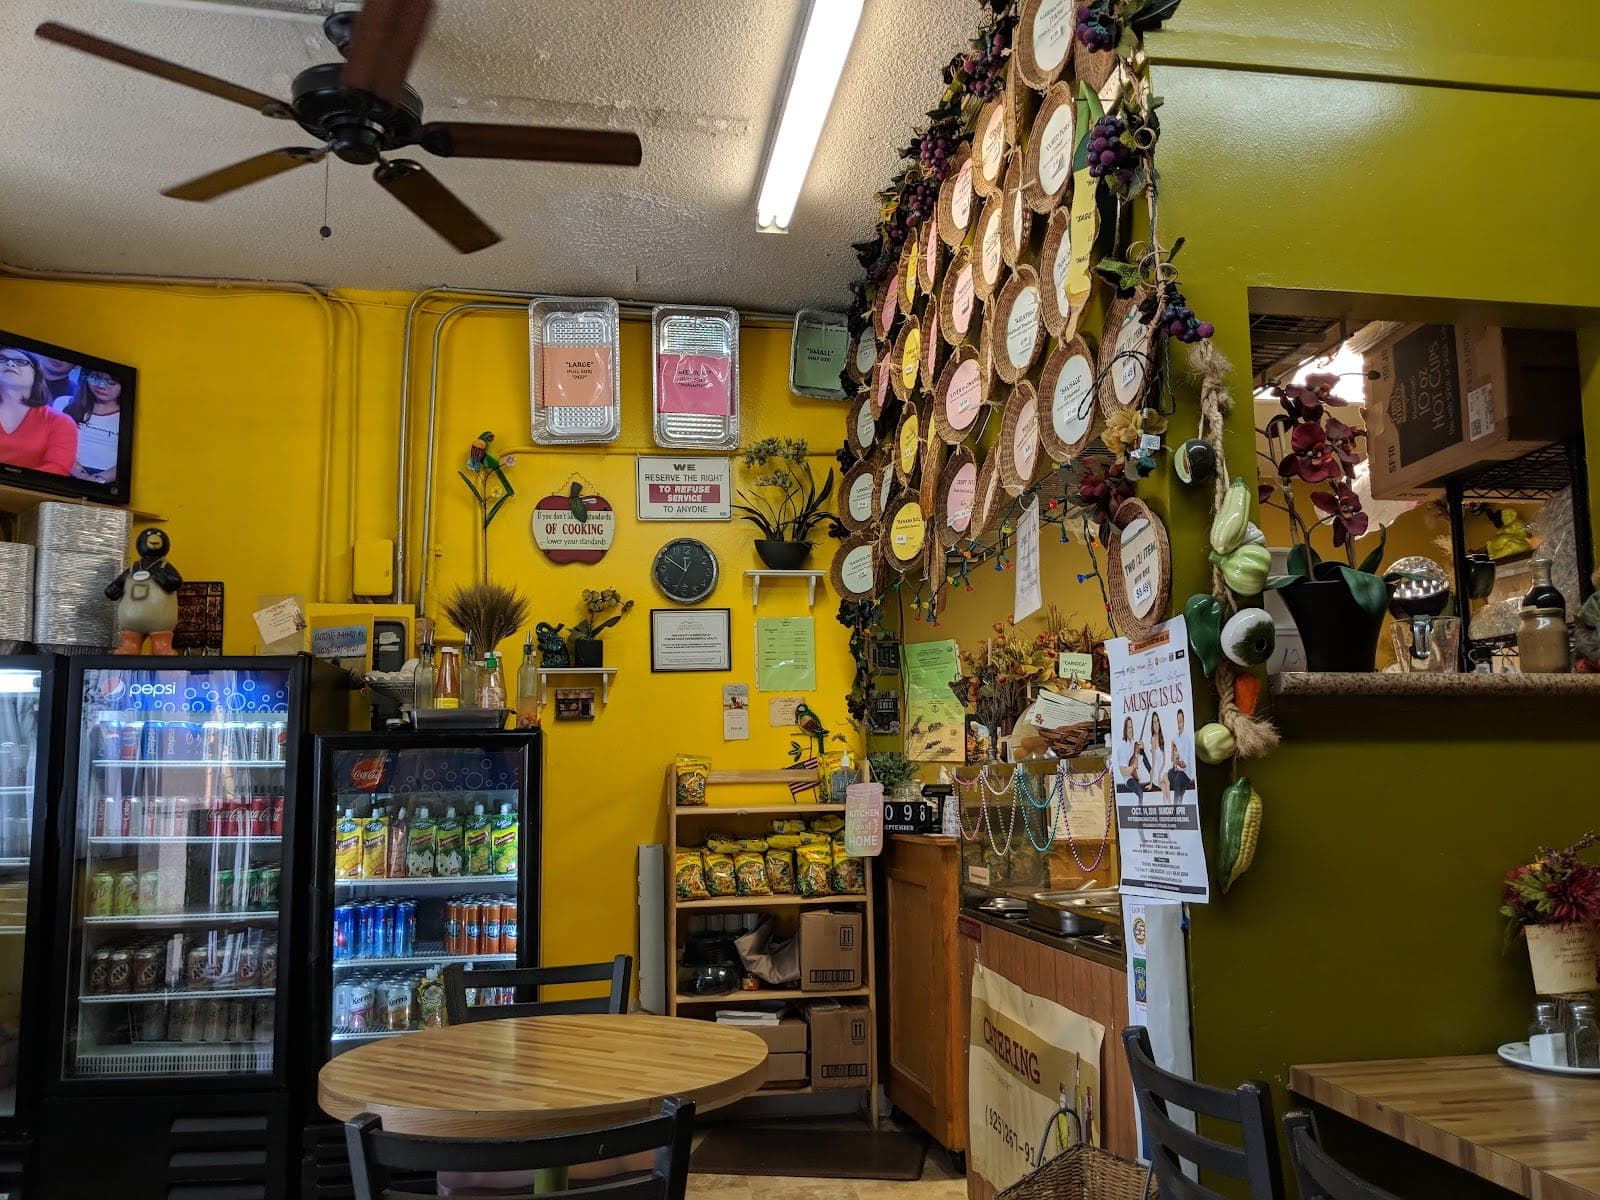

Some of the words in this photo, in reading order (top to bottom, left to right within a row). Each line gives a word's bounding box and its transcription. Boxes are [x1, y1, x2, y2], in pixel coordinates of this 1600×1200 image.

[645, 474, 680, 482] RESERVE
[683, 474, 698, 482] THE
[701, 474, 723, 482] RIGHT
[659, 486, 671, 494] TO
[675, 486, 710, 494] REFUSE
[545, 523, 557, 534] OF
[563, 523, 603, 535] COOKING
[129, 682, 176, 697] pepsi
[1123, 689, 1158, 713] MUSIC
[1160, 685, 1169, 707] IS
[1170, 682, 1184, 704] US
[849, 808, 880, 817] KITCHEN
[849, 836, 878, 846] HOME
[983, 1017, 1041, 1085] CATERING
